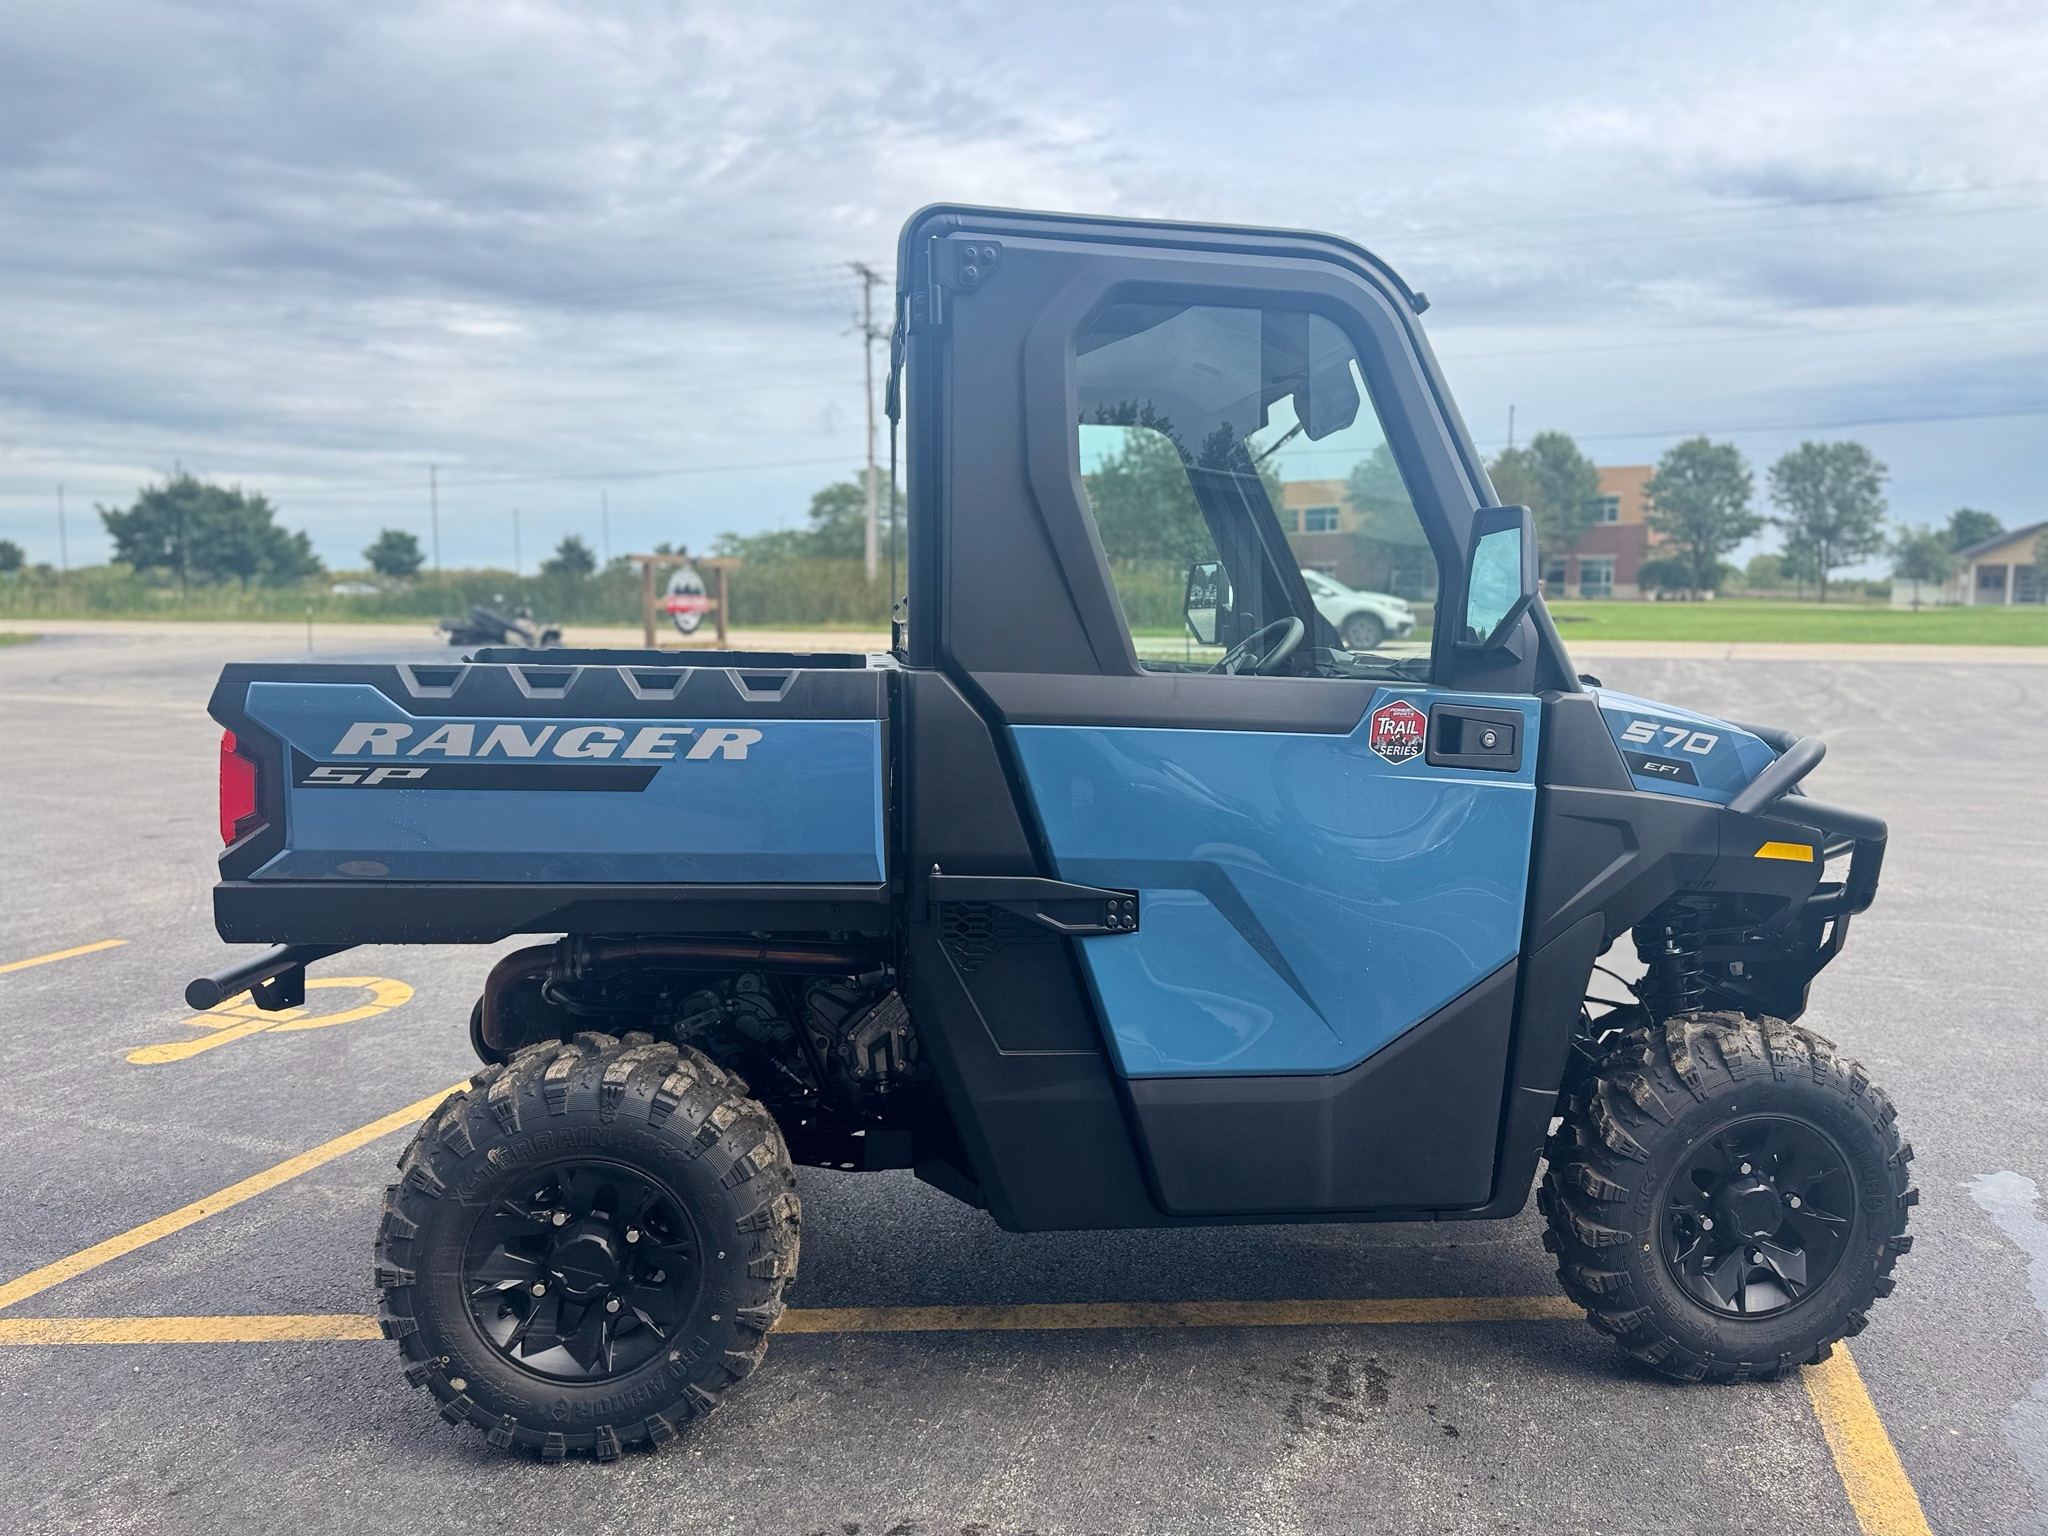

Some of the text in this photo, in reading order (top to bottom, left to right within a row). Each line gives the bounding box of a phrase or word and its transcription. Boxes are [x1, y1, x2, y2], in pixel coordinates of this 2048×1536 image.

[1377, 717, 1419, 735] TRAIL
[331, 721, 764, 760] RANGER
[1620, 719, 1719, 755] 570
[1379, 745, 1418, 756] SERIES
[301, 766, 431, 785] SP
[1643, 761, 1680, 775] EFI
